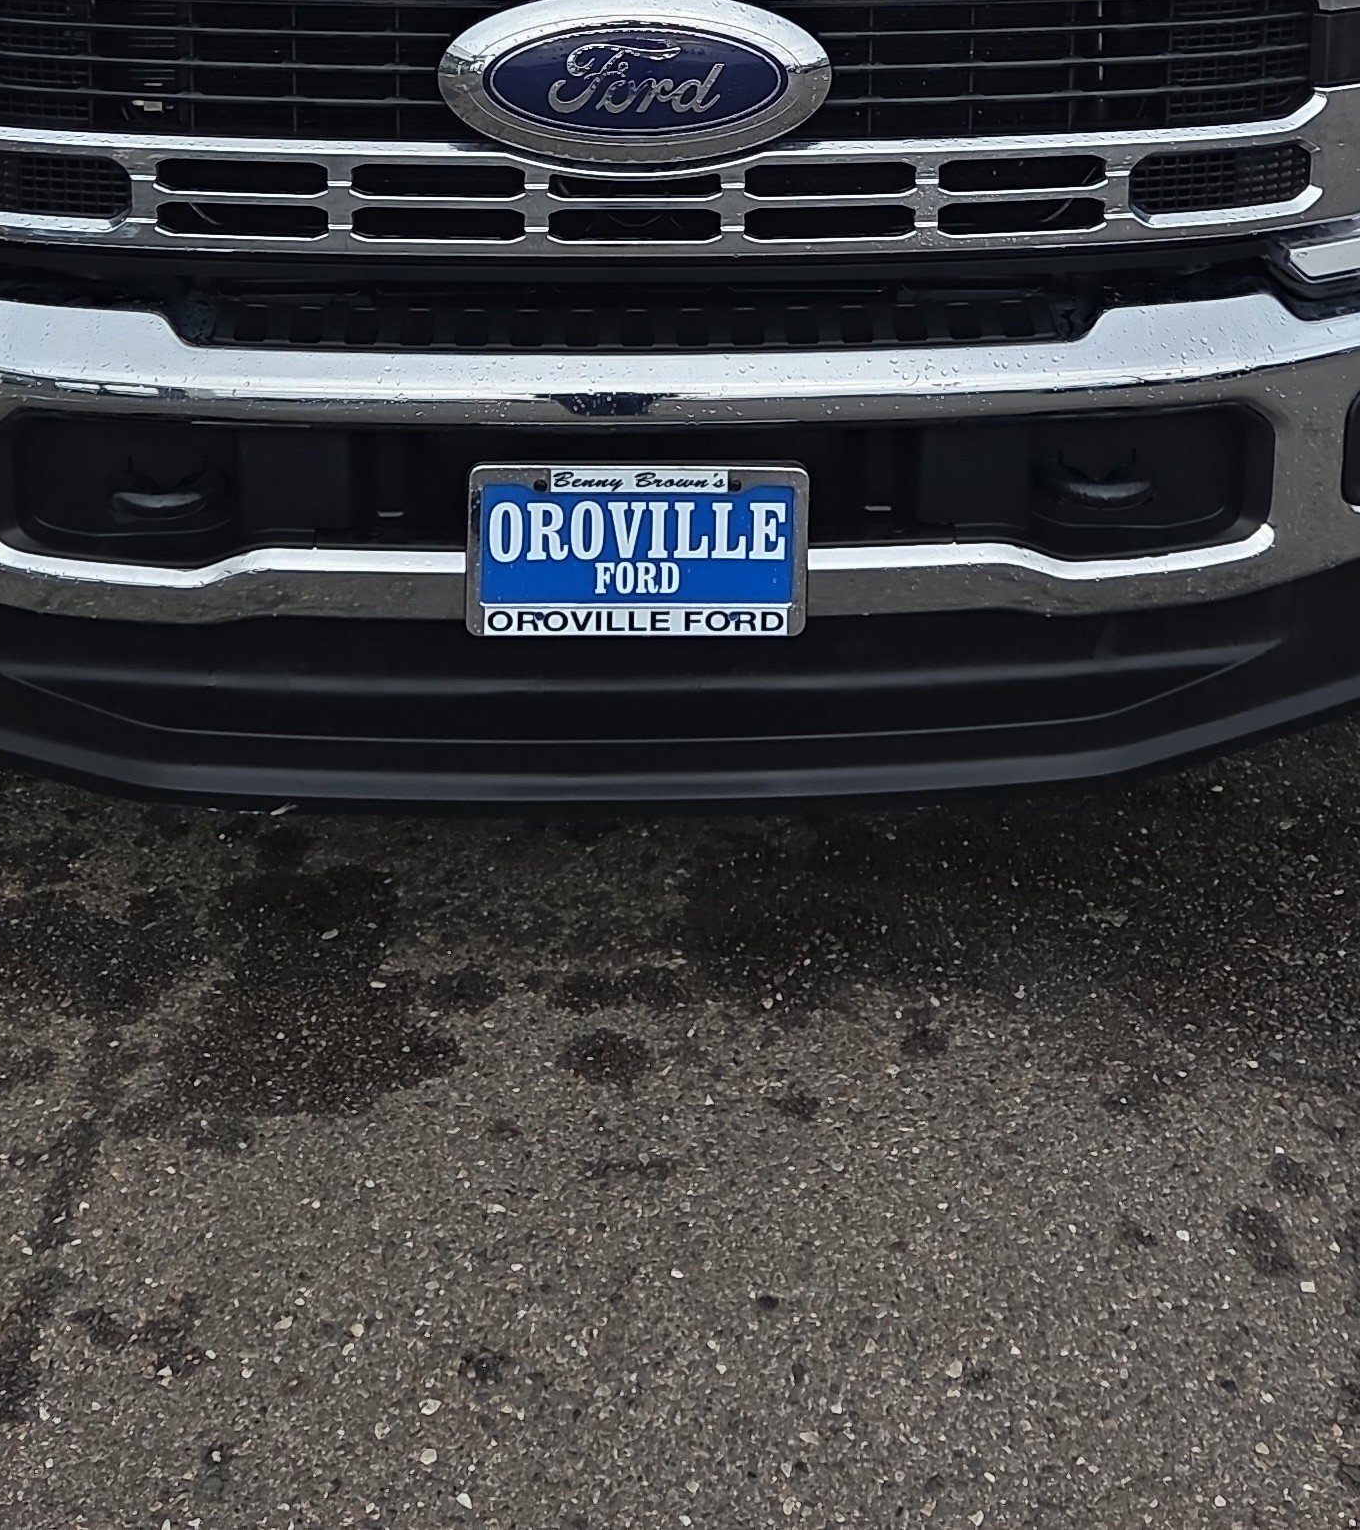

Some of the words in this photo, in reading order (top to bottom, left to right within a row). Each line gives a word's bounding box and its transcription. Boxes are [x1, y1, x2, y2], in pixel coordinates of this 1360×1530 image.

[548, 43, 726, 114] Ford
[552, 471, 625, 492] Benny
[634, 470, 727, 490] Brown's
[489, 500, 787, 563] OROVILLE
[594, 561, 680, 595] FORD
[487, 610, 671, 632] OROVILLE
[683, 610, 785, 632] FORD
